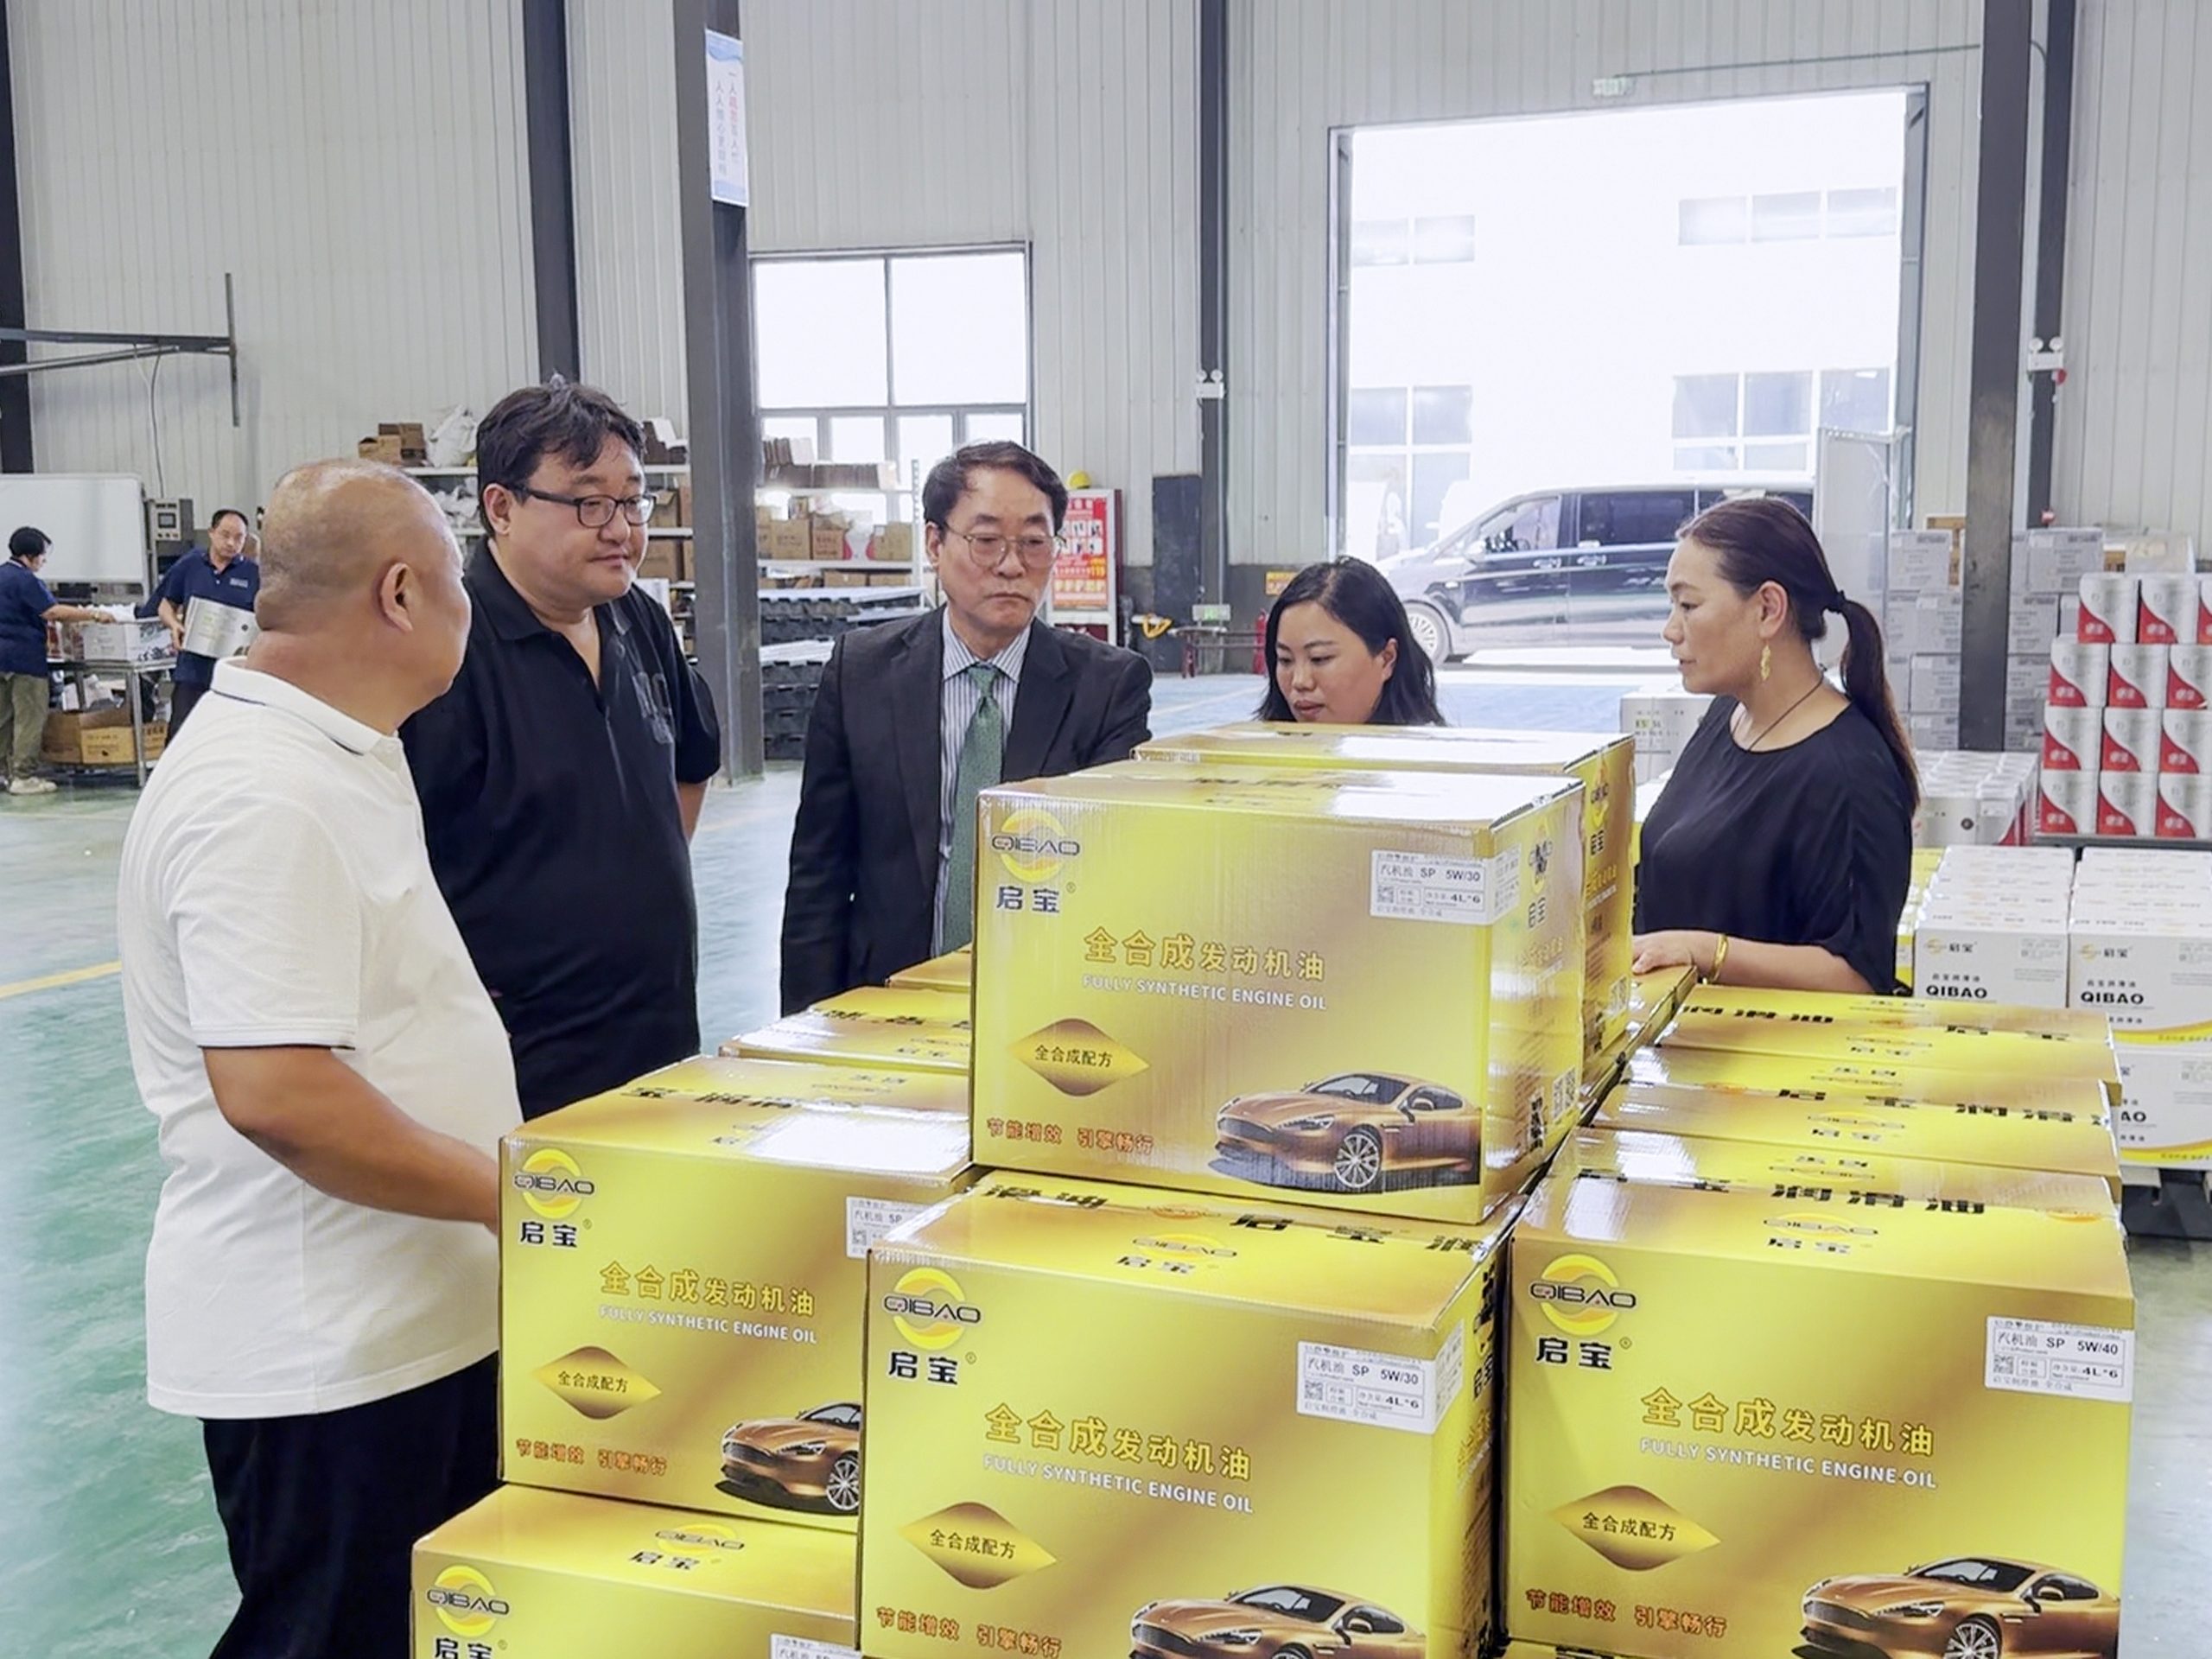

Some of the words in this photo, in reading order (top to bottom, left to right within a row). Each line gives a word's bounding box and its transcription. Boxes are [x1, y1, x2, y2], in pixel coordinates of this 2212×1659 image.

[992, 836, 1080, 856] QIBAO
[1420, 868, 1435, 879] SP
[996, 886, 1060, 912] 启宝
[1084, 926, 1325, 982] 全合成发动机油
[1084, 976, 1135, 992] FULLY
[1137, 978, 1226, 1002] SYNTHETIC
[1232, 988, 1294, 1008] ENGINE
[1299, 995, 1327, 1010] OIL
[1926, 984, 1987, 999] QIBAO
[2081, 990, 2145, 1005] QIBAO
[1035, 1045, 1113, 1068] 全合成配方
[987, 1117, 1063, 1145] 节能增效
[1077, 1127, 1154, 1155] 引擎畅行
[514, 1173, 595, 1195] QIBAO
[520, 1221, 578, 1248] 启宝
[600, 1261, 815, 1317] 全合成发动机油
[1529, 1281, 1637, 1311] QIBAO
[600, 1304, 644, 1323] FULLY
[648, 1312, 728, 1333] SYNTHETIC
[734, 1320, 788, 1341] ENGINE
[792, 1328, 817, 1344] OIL
[883, 1294, 982, 1325] QIBAO
[1536, 1337, 1613, 1370] 启宝
[2046, 1337, 2065, 1349] SP
[2077, 1340, 2119, 1356] 5W/40
[558, 1370, 629, 1393] 全合成配方
[888, 1351, 959, 1385] 启宝
[1352, 1363, 1370, 1377] SP
[1381, 1370, 1419, 1385] 5W/30
[1640, 1387, 1935, 1458] 全合成发动机油
[516, 1438, 585, 1465] 节能增效
[598, 1449, 668, 1476] 引擎畅行
[985, 1402, 1251, 1481] 全合成发动机油
[1640, 1437, 1700, 1461] FULLY
[1705, 1446, 1815, 1474] SYNTHETIC
[1821, 1459, 1897, 1484] ENGINE
[1903, 1471, 1938, 1490] OIL
[982, 1454, 1039, 1477] FULLY
[1042, 1464, 1143, 1496] SYNTHETIC
[1148, 1481, 1217, 1509] ENGINE
[1223, 1492, 1254, 1514] OIL
[1582, 1511, 1677, 1542] 全合成配方
[930, 1528, 1016, 1560] 全合成配方
[427, 1588, 511, 1616] QIBAO
[1526, 1587, 1617, 1623] 节能增效
[1634, 1605, 1727, 1639] 引擎畅行
[876, 1605, 960, 1642] 节能增效
[976, 1624, 1062, 1659] 引擎畅行
